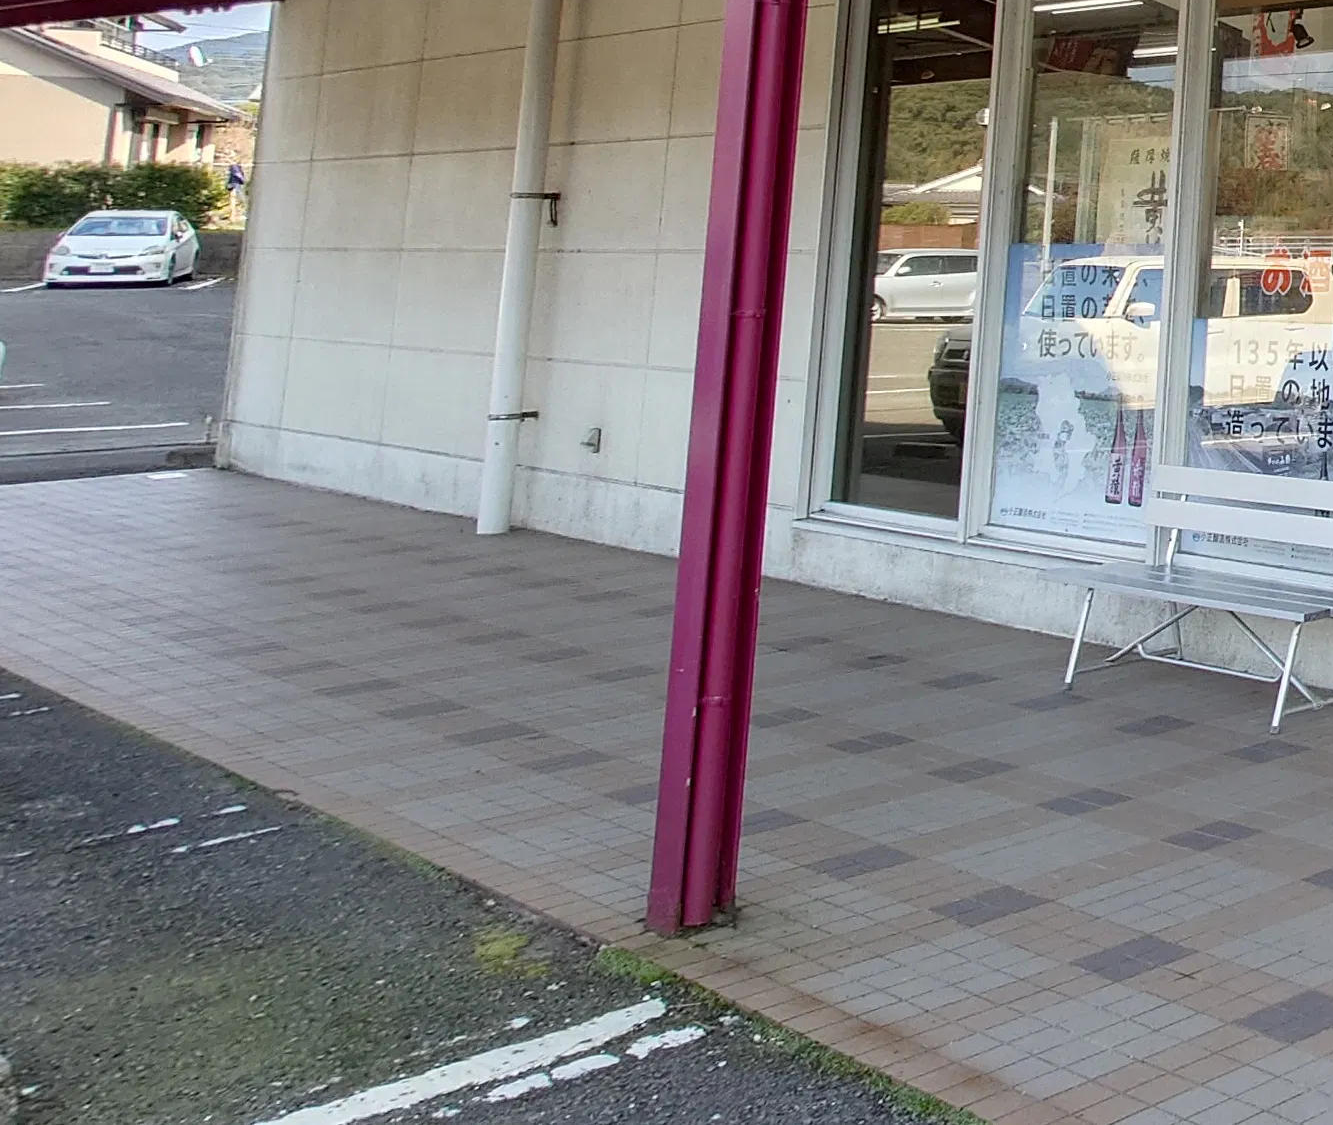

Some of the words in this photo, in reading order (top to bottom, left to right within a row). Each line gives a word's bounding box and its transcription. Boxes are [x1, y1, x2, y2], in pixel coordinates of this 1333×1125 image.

[1261, 247, 1332, 296] お酒
[1038, 328, 1144, 363] 使っています。
